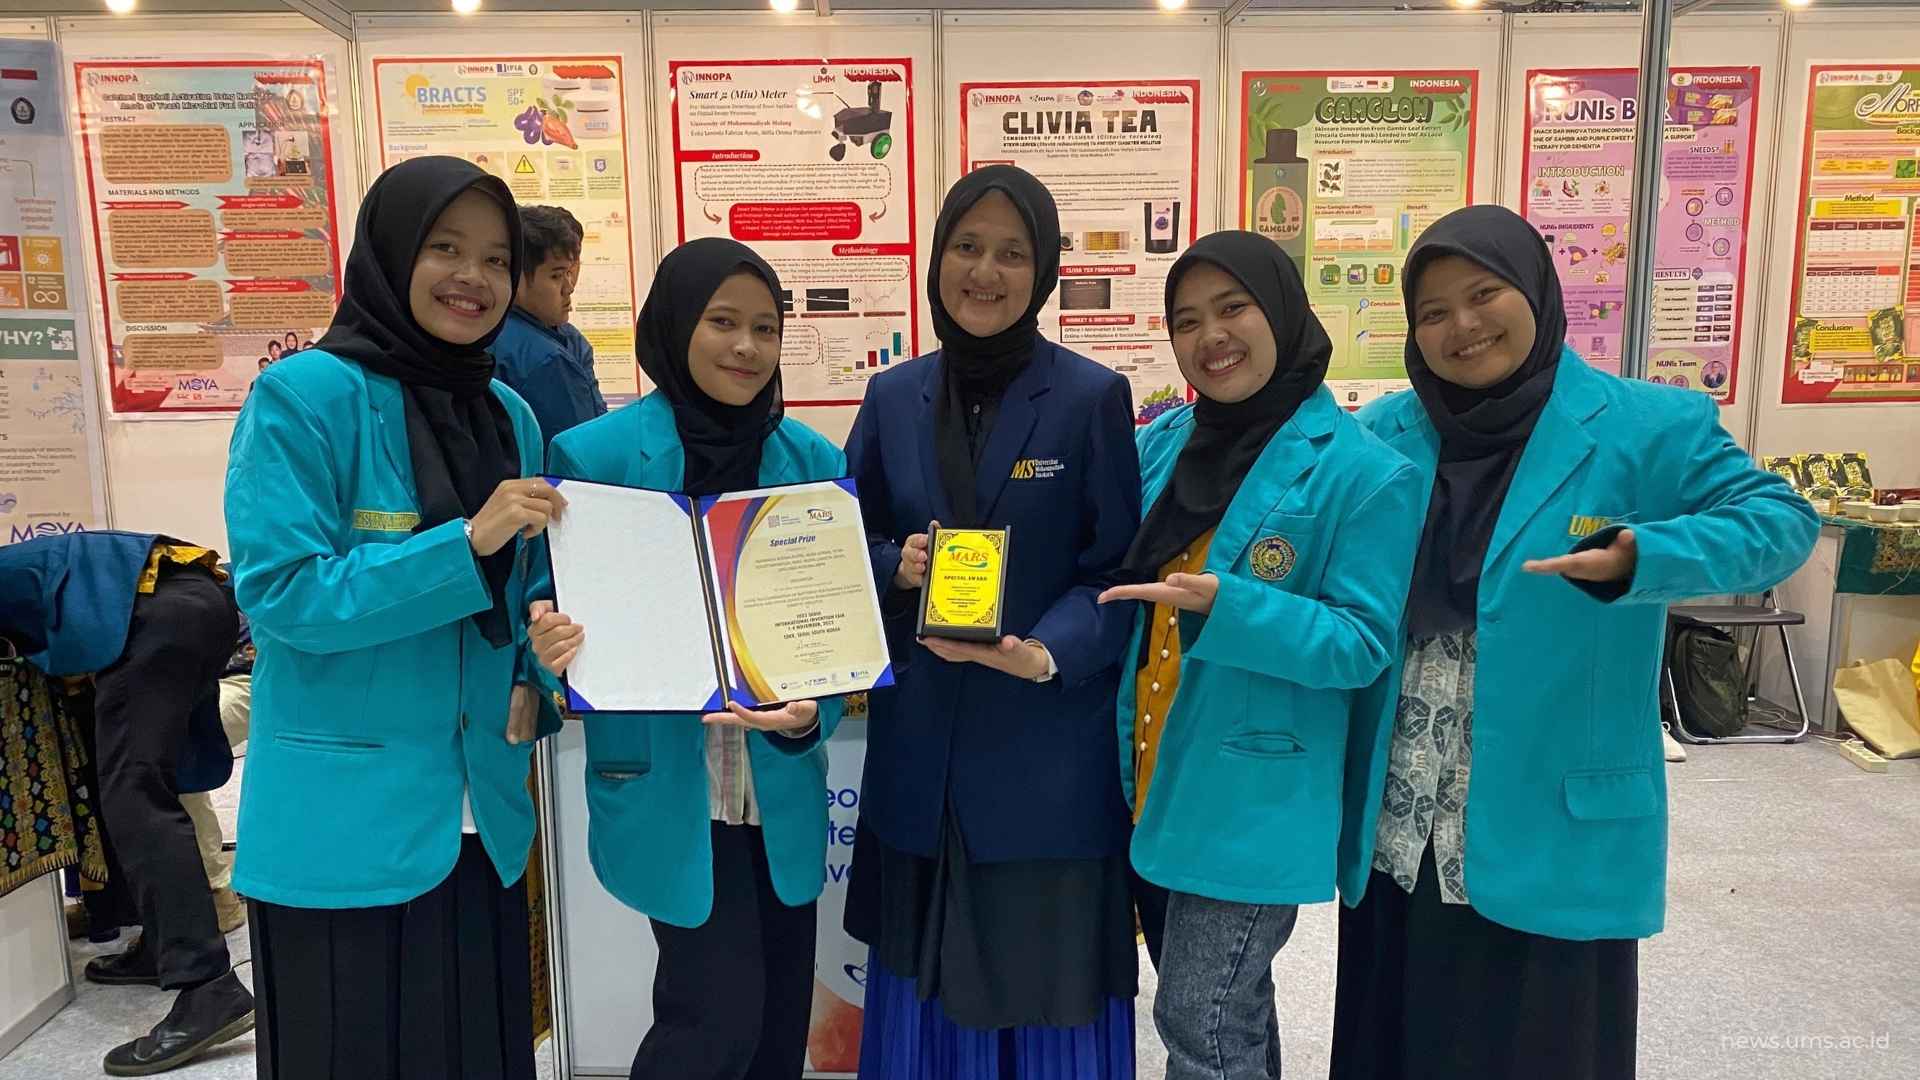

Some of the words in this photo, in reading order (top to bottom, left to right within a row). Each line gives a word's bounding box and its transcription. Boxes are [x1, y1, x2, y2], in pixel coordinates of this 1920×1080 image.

[100, 74, 138, 82] INNOPA
[696, 73, 732, 81] INNOPA
[1692, 76, 1743, 84] INDONESIA
[1410, 80, 1461, 88] INDONESIA
[417, 86, 487, 102] BRACTS
[690, 90, 718, 100] Smart
[730, 90, 758, 100] (Miu)
[760, 90, 788, 100] Meter
[985, 95, 1021, 103] INNOPA
[1002, 111, 1092, 134] CLIVIA
[1102, 110, 1158, 134] TEA
[388, 144, 428, 152] Background
[1538, 166, 1625, 178] INTRODUCTION
[165, 188, 200, 196] METHODS
[1844, 193, 1874, 202] Method
[1704, 218, 1740, 226] METHOD
[1259, 224, 1300, 232] GAMGLOW
[1816, 324, 1854, 332] Conclusion
[808, 509, 834, 520] MARS
[770, 535, 798, 548] Special
[798, 534, 817, 544] Prize
[948, 552, 990, 562] MARS
